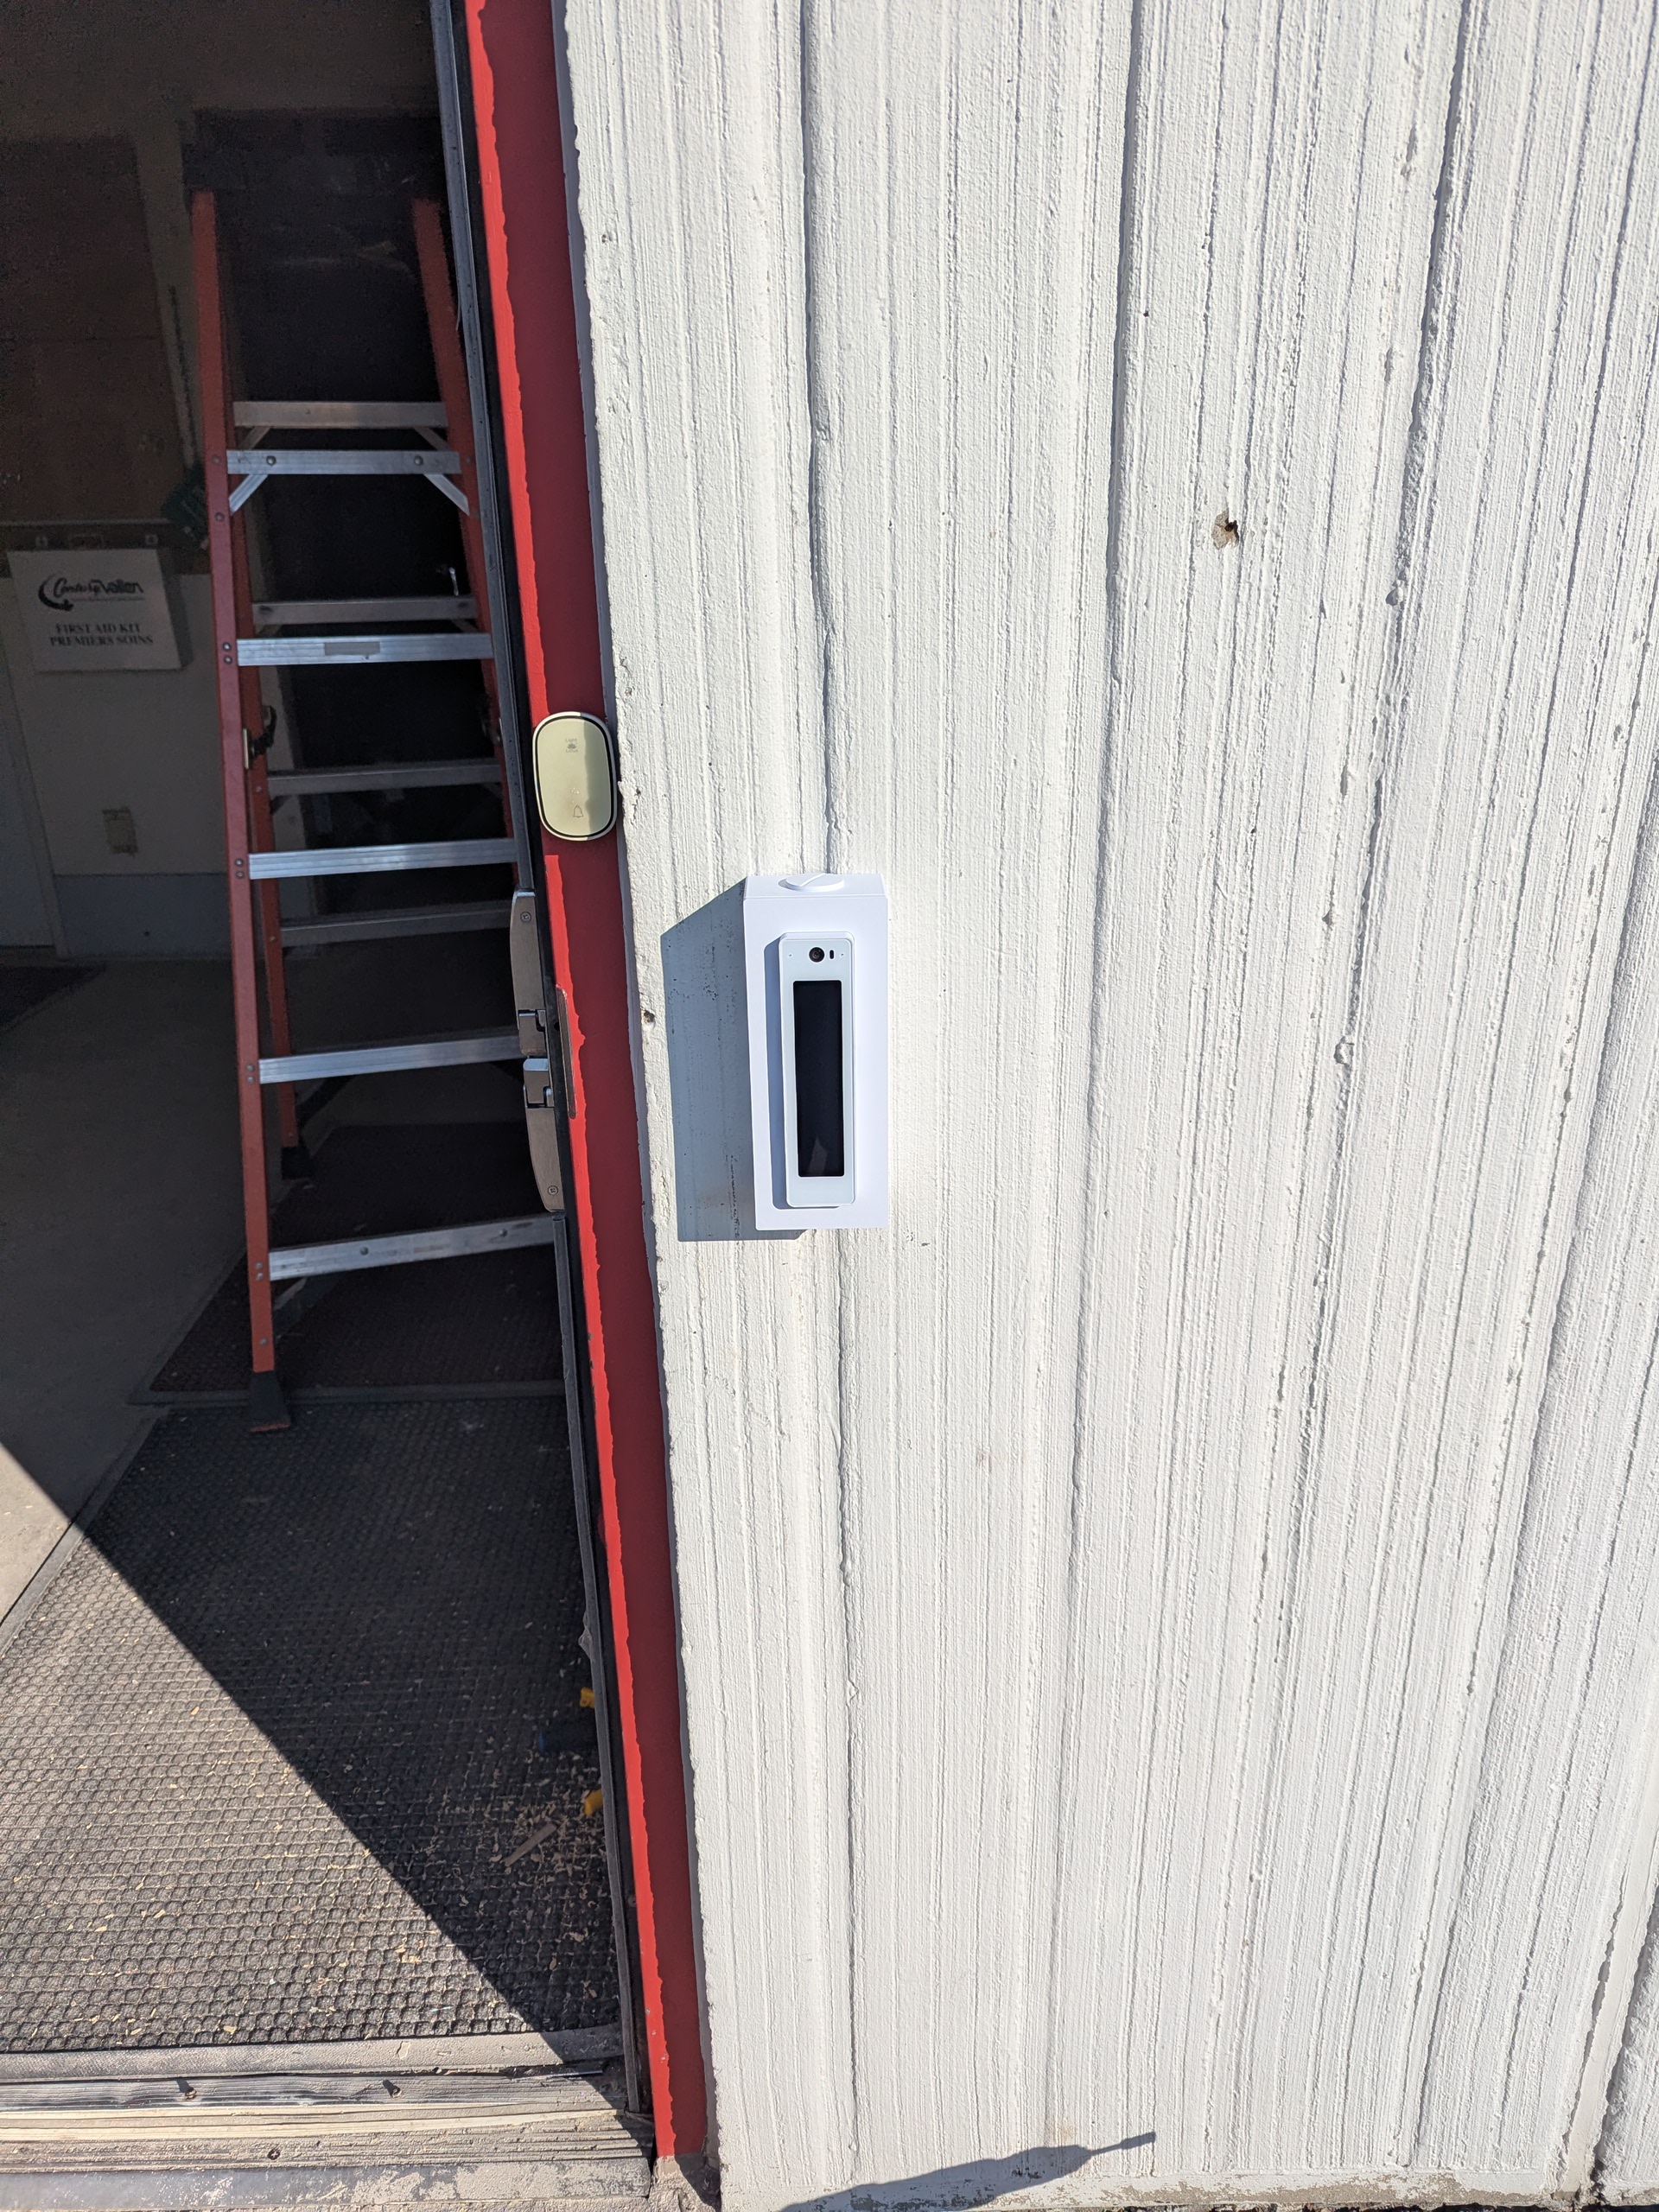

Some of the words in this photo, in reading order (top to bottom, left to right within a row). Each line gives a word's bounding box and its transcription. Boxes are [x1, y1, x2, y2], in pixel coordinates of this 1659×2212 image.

[55, 623, 91, 633] FIRST
[96, 623, 117, 633] AID
[119, 623, 141, 633] KIT
[49, 635, 114, 646] PREMIERS
[116, 634, 153, 645] SOINS
